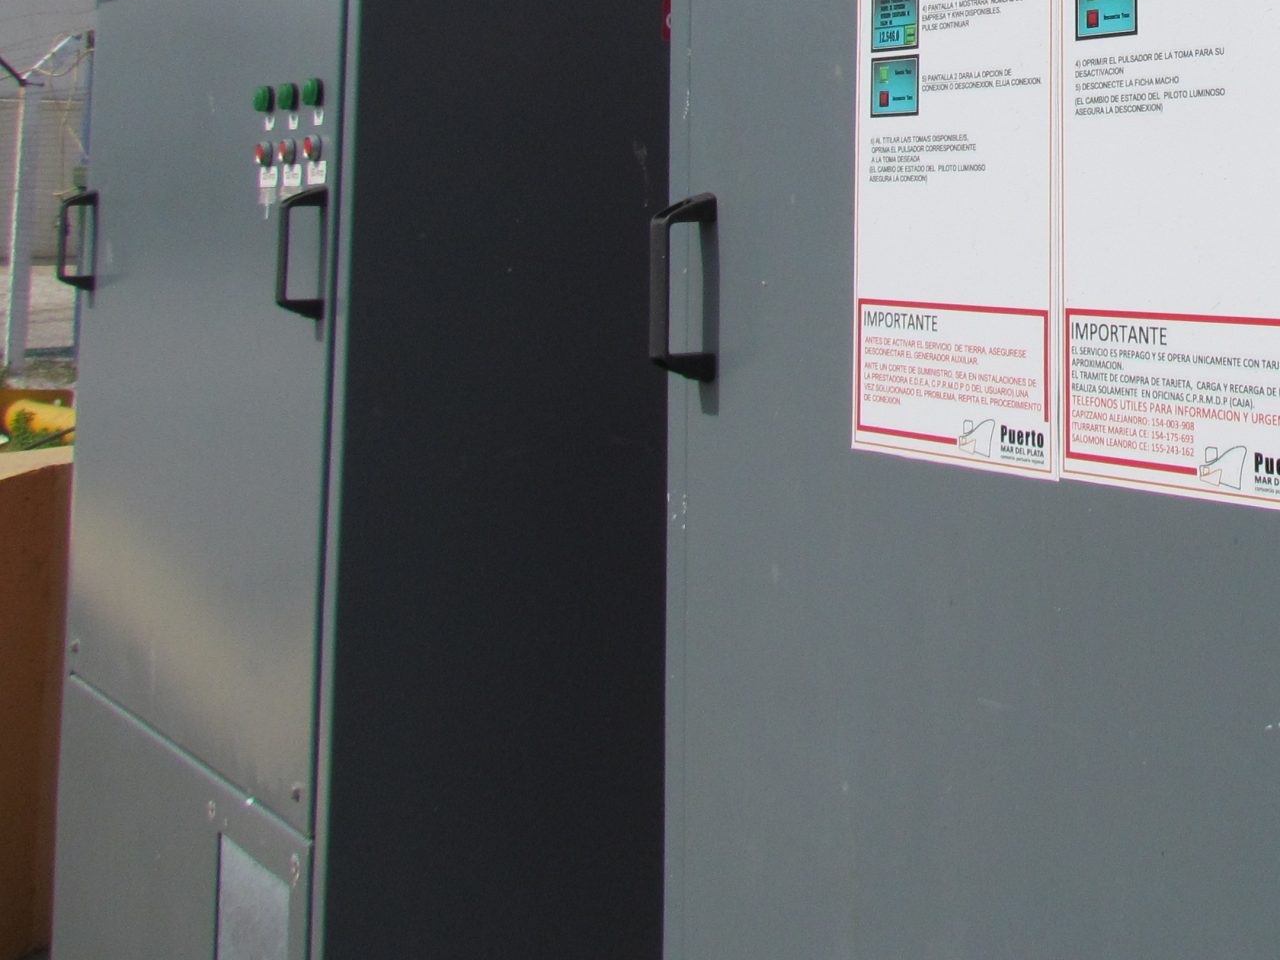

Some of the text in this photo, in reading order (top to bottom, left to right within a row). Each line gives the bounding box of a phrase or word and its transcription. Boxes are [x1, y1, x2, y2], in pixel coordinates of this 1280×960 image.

[1082, 57, 1107, 67] OPRIMIR
[1117, 53, 1152, 64] PULSADOR
[1174, 50, 1193, 60] TOMA
[1194, 49, 1212, 58] PARA
[1075, 67, 1124, 78] DESACTIVACION
[1081, 80, 1123, 91] DESCONECTE
[1134, 78, 1153, 87] FICHA
[1154, 76, 1179, 86] MACHO
[1085, 95, 1109, 105] CAMBIO
[1120, 93, 1146, 103] ESTADO
[1147, 92, 1160, 101] DEL
[1163, 91, 1187, 100] PILOTO
[1189, 88, 1225, 99] LUMINOSO
[1075, 106, 1104, 115] ASEGURA
[1114, 104, 1163, 114] DESCONEXION)
[864, 311, 938, 331] IMPORTANTE
[1071, 322, 1167, 345] IMPORTANTE
[1079, 347, 1108, 357] SERVICIO
[1118, 350, 1150, 360] PREPAGO
[1167, 353, 1190, 363] OPERA
[1192, 355, 1240, 367] UNICAMENTE
[1243, 358, 1259, 368] CON
[1072, 383, 1096, 393] REALIZA
[1098, 385, 1137, 397] SOLAMENTE
[1152, 390, 1184, 402] OFICINAS
[1080, 371, 1108, 382] TRAMITE
[1120, 375, 1149, 385] COMPRA
[1196, 381, 1221, 392] CARGA
[1229, 383, 1264, 395] RECARGA
[1072, 395, 1118, 410] TELEFONOS
[1121, 400, 1147, 413] UTILES
[1151, 403, 1171, 415] PARA
[1175, 406, 1241, 423] INFORMACION
[1072, 410, 1107, 422] CAPIZZANO
[1152, 417, 1194, 430] 154-003-908
[1001, 425, 1044, 448] Puerto
[1108, 426, 1137, 437] MARIELA
[1152, 430, 1194, 443] 154-175-693
[1072, 434, 1104, 446] SALOMON
[1106, 438, 1137, 450] LEANDRO
[1152, 443, 1194, 456] 155-243-162
[1254, 476, 1272, 486] MAR
